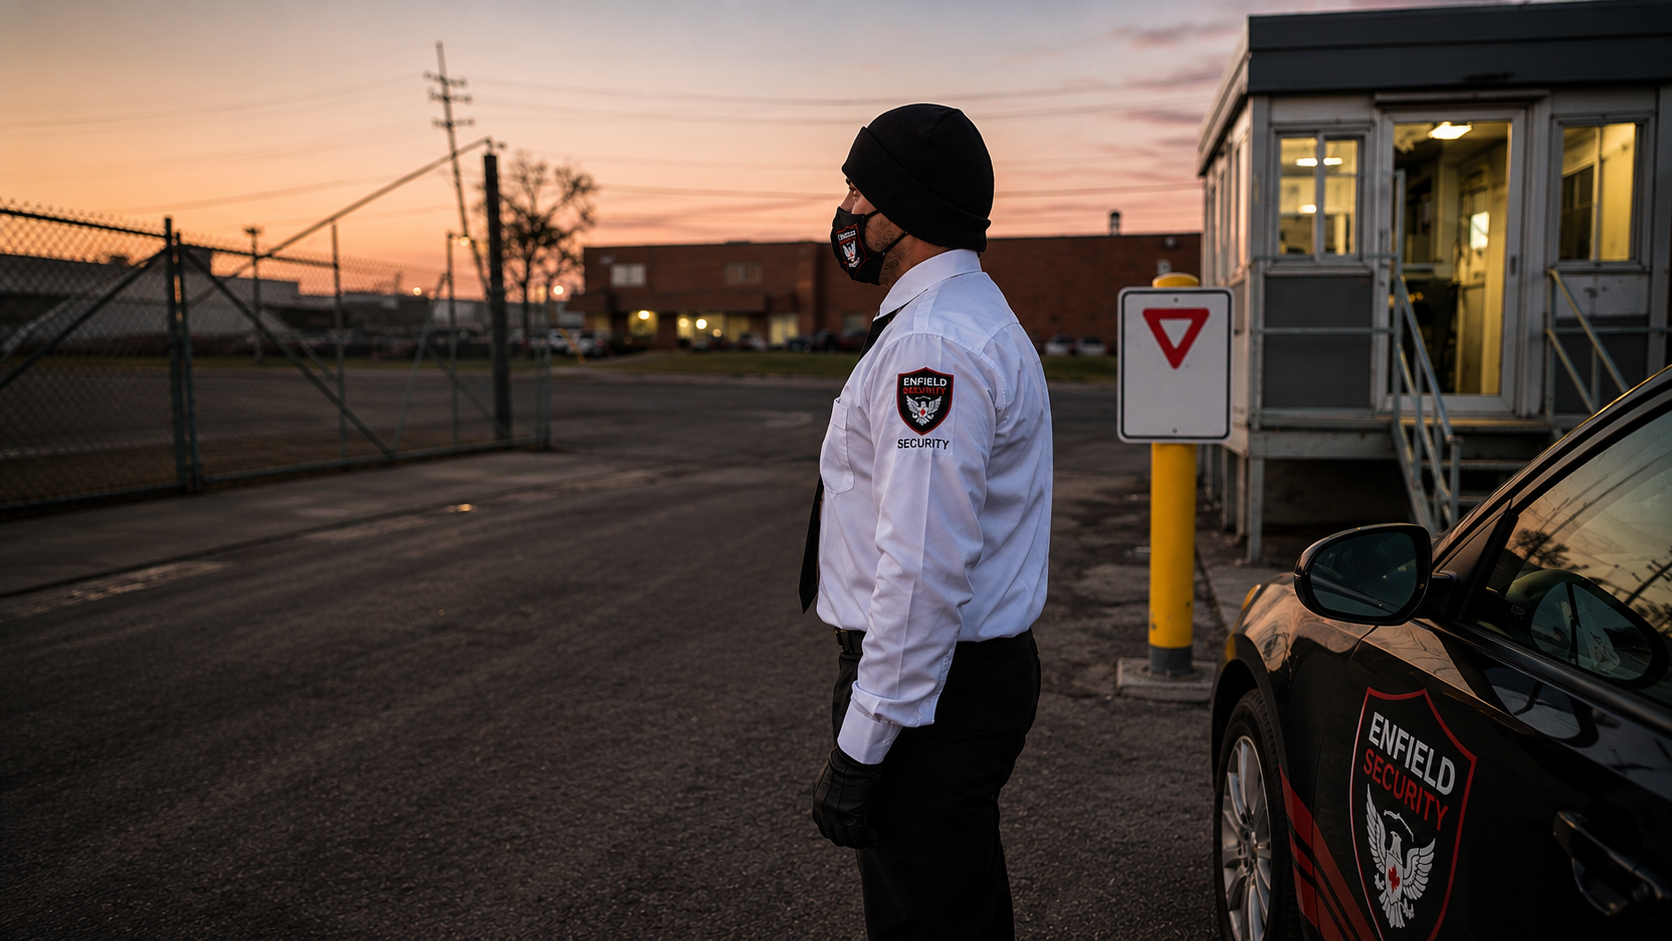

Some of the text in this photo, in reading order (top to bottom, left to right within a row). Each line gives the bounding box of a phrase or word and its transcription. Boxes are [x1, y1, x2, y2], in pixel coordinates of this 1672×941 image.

[903, 377, 947, 387] ENFIELD
[897, 438, 950, 450] SECURITY
[1368, 711, 1456, 795] ENFIELD
[1363, 748, 1449, 831] SECURITY
